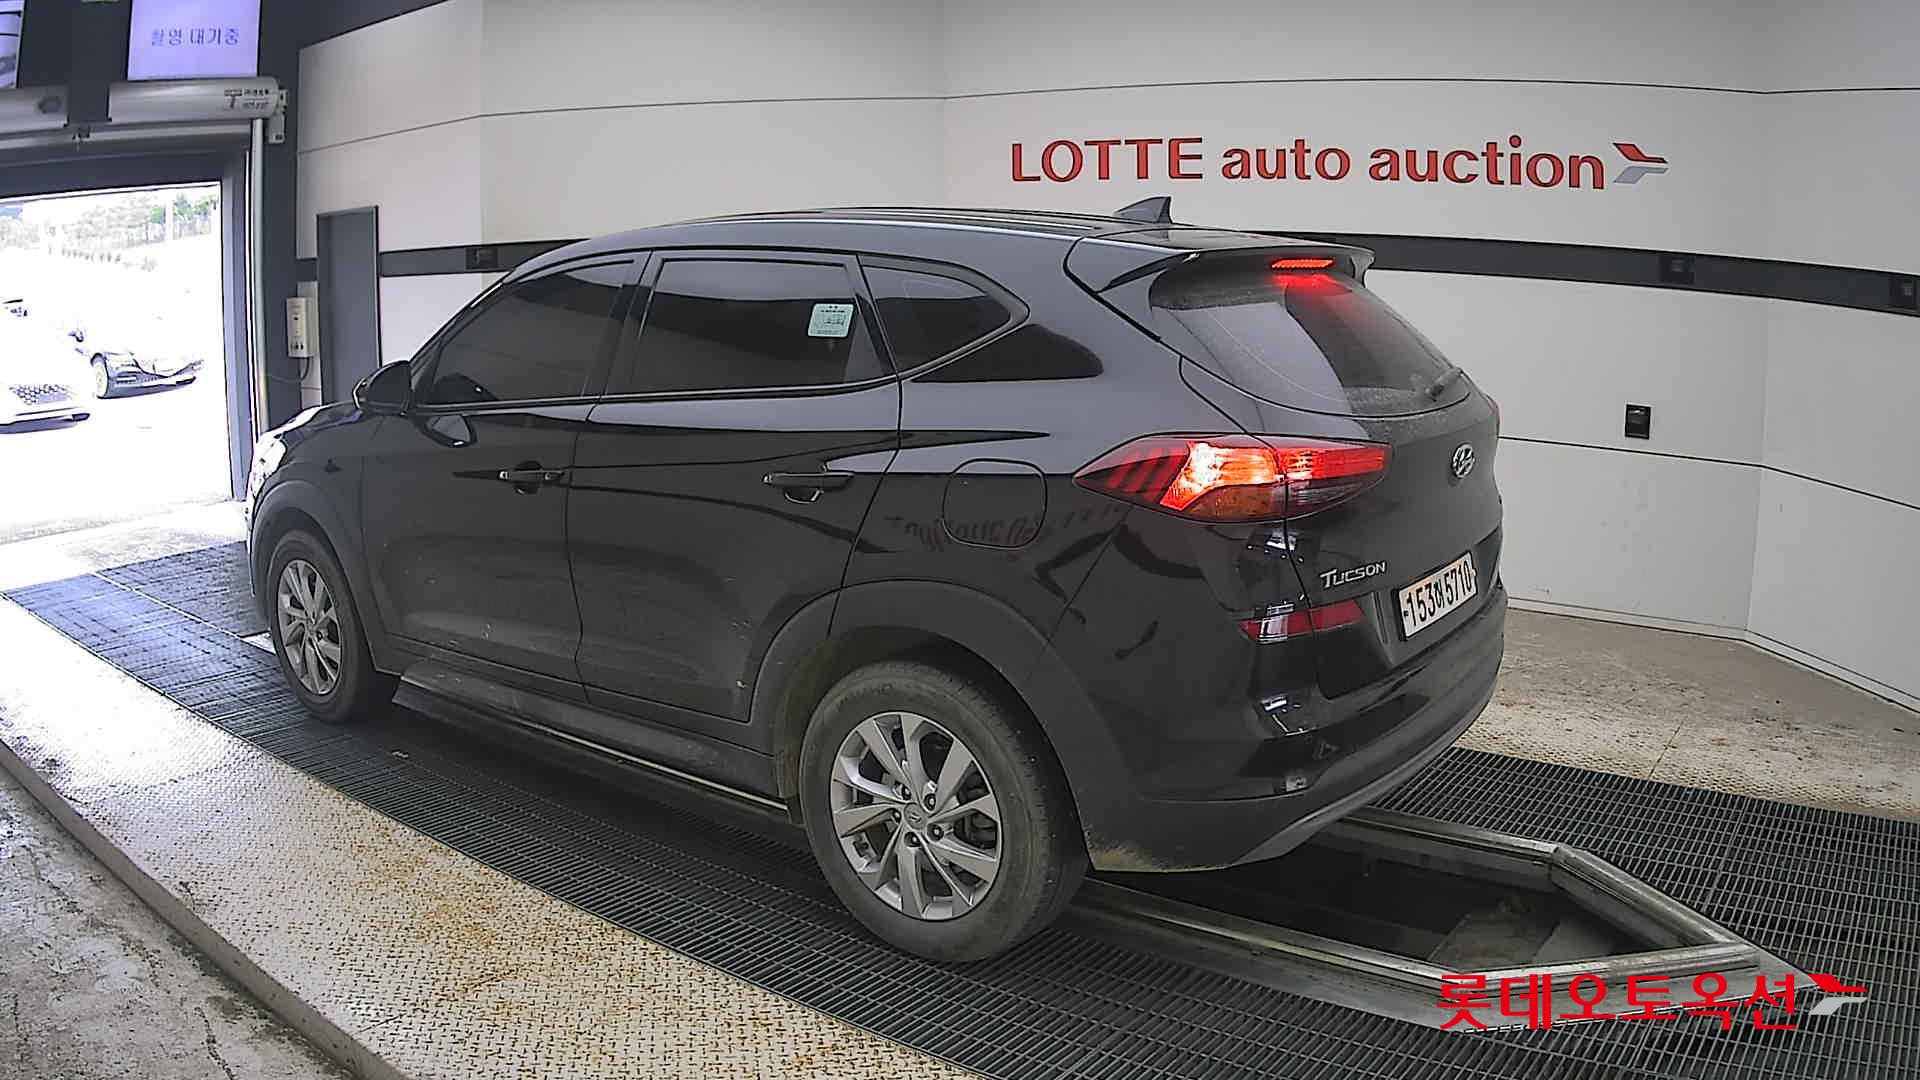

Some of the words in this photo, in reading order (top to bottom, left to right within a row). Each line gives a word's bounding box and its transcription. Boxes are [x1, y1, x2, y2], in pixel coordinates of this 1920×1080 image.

[189, 27, 239, 46] 대기중
[1010, 136, 1204, 182] LOTTE
[1221, 138, 1352, 181] auto
[1368, 135, 1606, 189] auction
